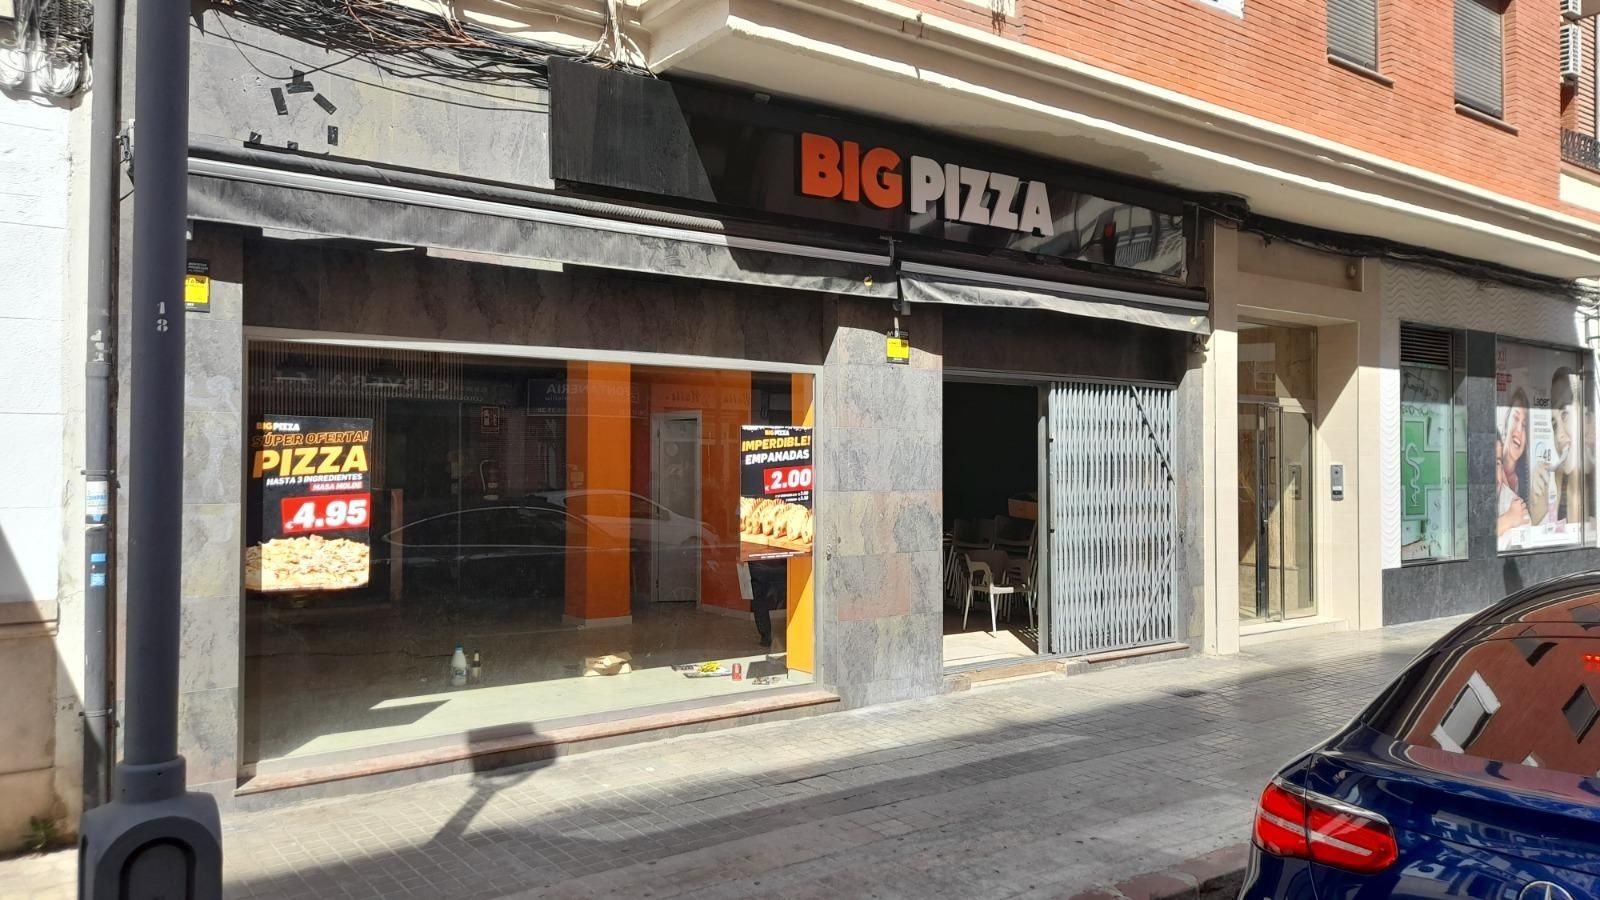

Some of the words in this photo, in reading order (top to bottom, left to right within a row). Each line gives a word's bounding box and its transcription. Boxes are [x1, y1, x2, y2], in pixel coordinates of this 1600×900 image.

[801, 132, 903, 209] BIG
[910, 155, 1054, 236] PIZZA
[256, 422, 273, 430] BIG
[273, 422, 300, 431] PIZZA
[251, 432, 304, 447] SÚPER
[306, 430, 369, 445] OFERTA!
[742, 435, 811, 452] IMPERDIBLE!
[252, 445, 368, 478] PIZZA
[745, 449, 810, 465] EMPANADAS
[266, 476, 297, 486] HASTA
[297, 475, 303, 484] 3
[303, 472, 363, 483] INGREDIENTES
[313, 483, 335, 491] MASA
[336, 481, 363, 489] MOLDE
